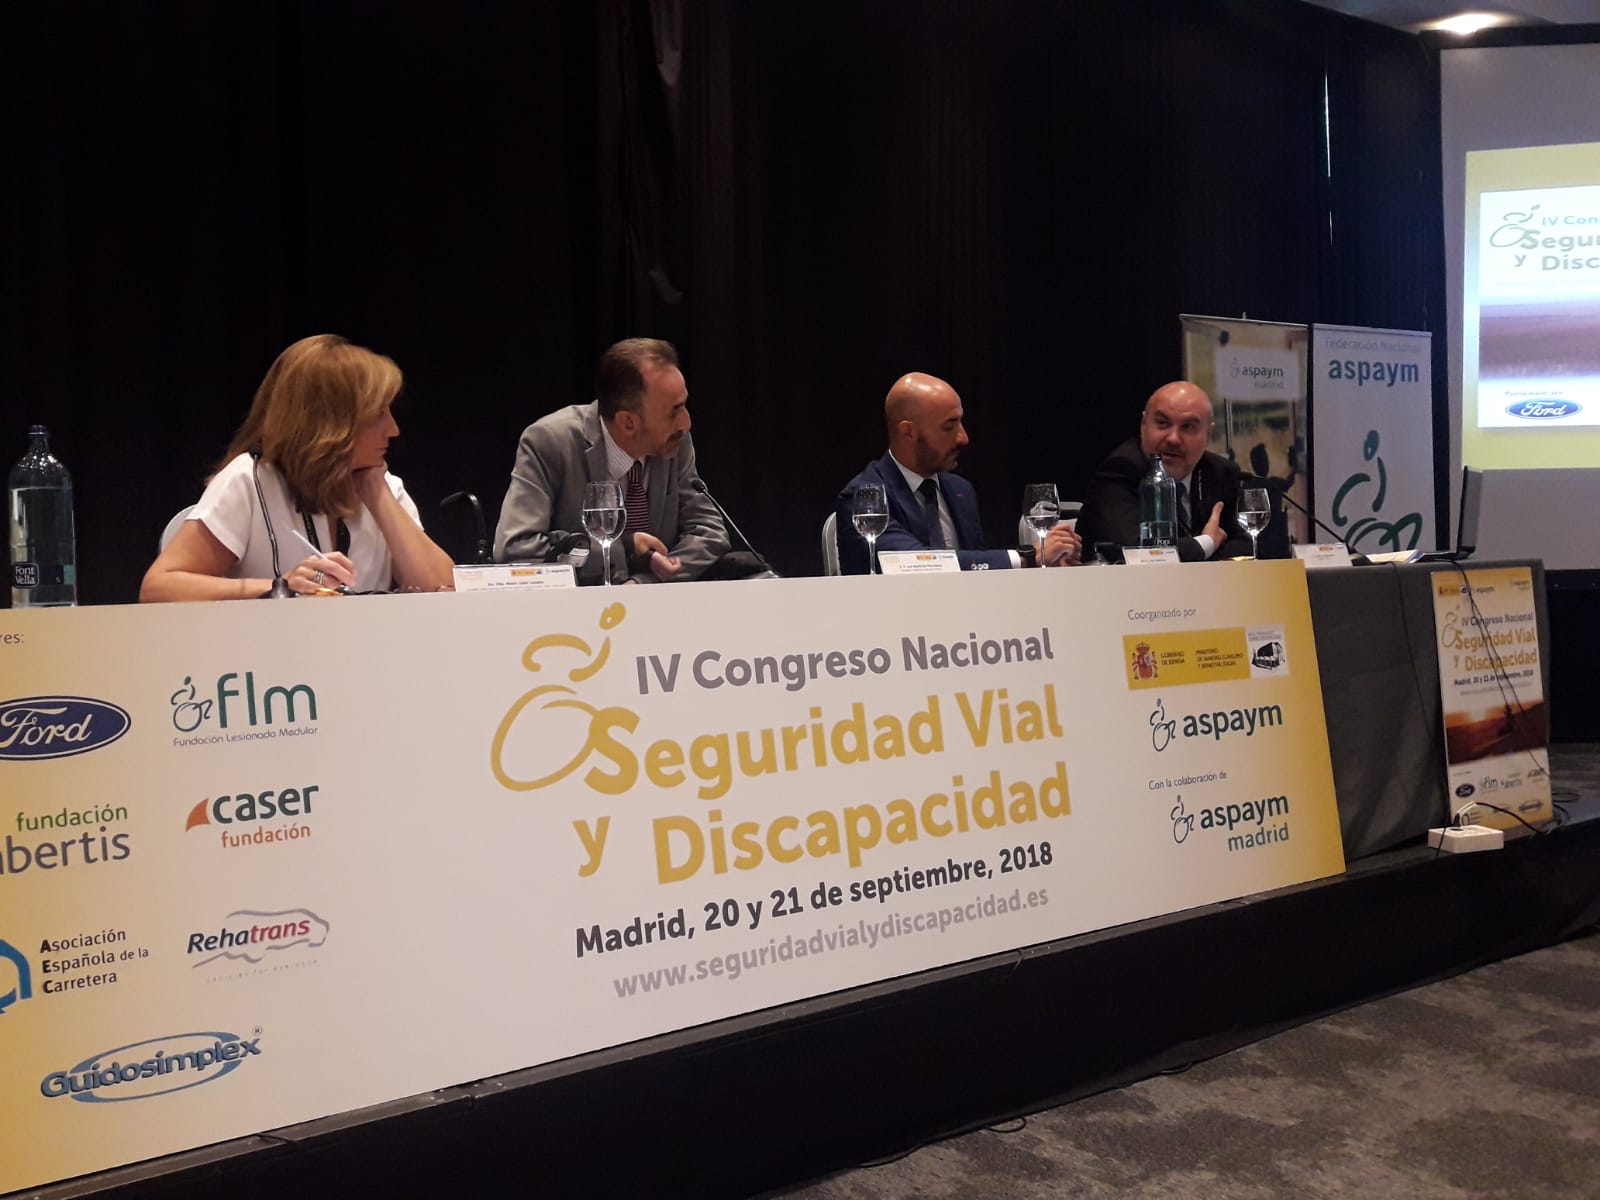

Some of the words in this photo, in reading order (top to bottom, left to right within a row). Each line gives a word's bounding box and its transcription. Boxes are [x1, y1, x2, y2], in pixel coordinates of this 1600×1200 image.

[1514, 254, 1527, 267] y
[1242, 366, 1284, 379] aspaym
[1328, 359, 1419, 387] aspaym
[1521, 401, 1567, 416] Ford
[15, 566, 35, 575] Font
[15, 574, 35, 584] Vella
[1184, 609, 1198, 619] por
[1515, 626, 1536, 644] Vial
[635, 654, 681, 695] IV
[692, 647, 891, 692] Congreso
[900, 628, 1054, 672] Nacional
[216, 671, 318, 729] flm
[0, 707, 93, 749] Ford
[279, 726, 319, 737] Medular
[1183, 704, 1282, 740] aspaym
[583, 695, 945, 801] Seguridad
[954, 683, 1063, 749] Vial
[1149, 780, 1164, 790] Con
[16, 804, 128, 832] fundación
[212, 785, 319, 824] caser
[1200, 795, 1289, 830] aspaym
[220, 823, 311, 848] fundación
[572, 815, 612, 878] y
[652, 761, 1072, 885] Discapacidad
[1228, 822, 1289, 852] madrid
[576, 908, 695, 958] Madrid,
[703, 898, 740, 931] 20
[746, 900, 763, 930] y
[770, 886, 804, 918] 21
[810, 881, 843, 910] de
[850, 858, 993, 903] septiembre,
[999, 841, 1053, 873] 2018
[40, 928, 126, 953] Asociación
[187, 919, 310, 954] Rehatrans
[613, 888, 1049, 998] www.seguridadvialydiscapacidad.es
[42, 949, 116, 974] Española
[120, 949, 136, 961] de
[138, 947, 149, 958] la
[42, 970, 117, 994] Carretera
[40, 1038, 262, 1098] Guidosimplex
